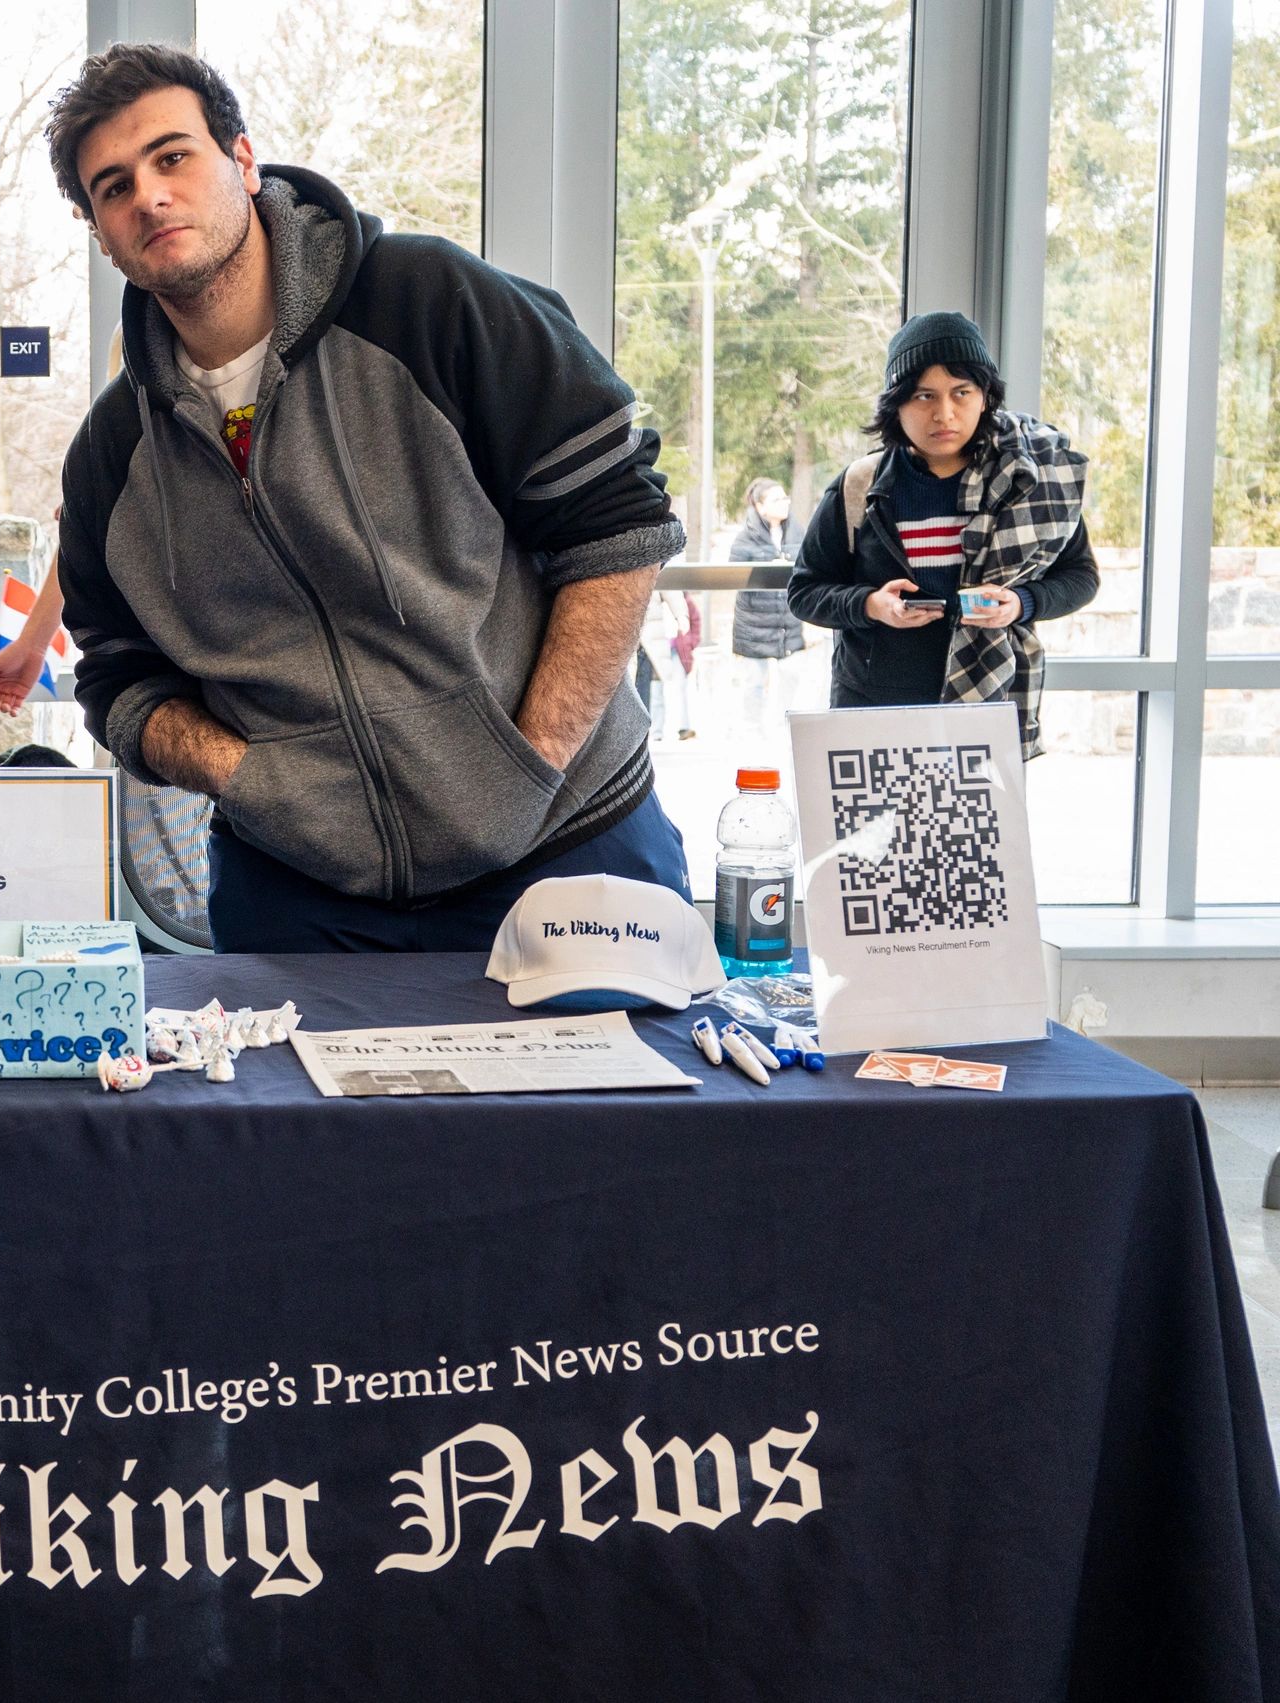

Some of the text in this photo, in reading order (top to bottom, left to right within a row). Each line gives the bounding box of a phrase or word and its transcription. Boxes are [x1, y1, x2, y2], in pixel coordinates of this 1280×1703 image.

[10, 342, 41, 354] EXIT
[749, 883, 785, 926] G
[542, 920, 660, 943] The Viking News
[866, 939, 991, 956] Viking News Recruitment Form
[325, 1041, 613, 1055] The Viking News
[312, 1356, 498, 1405] Premier
[511, 1341, 643, 1387] News
[659, 1323, 820, 1366] Source
[375, 1411, 823, 1575] News
